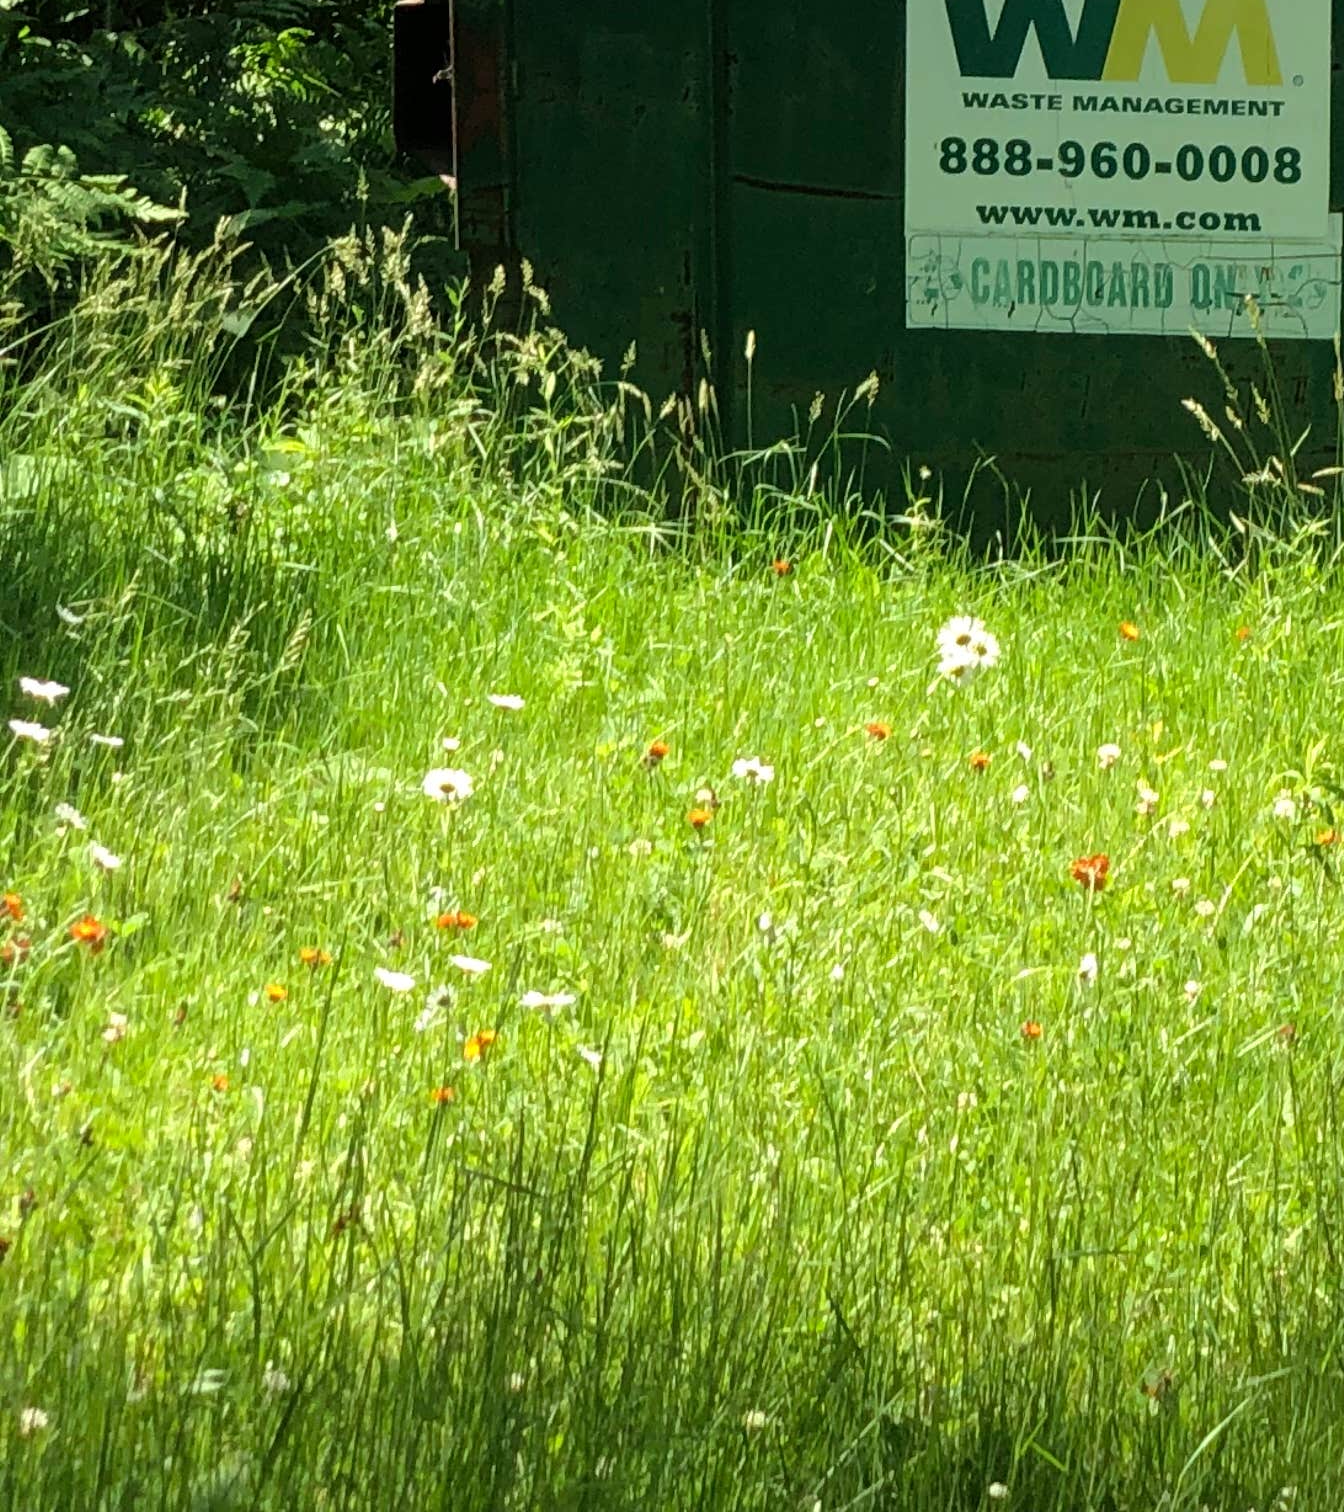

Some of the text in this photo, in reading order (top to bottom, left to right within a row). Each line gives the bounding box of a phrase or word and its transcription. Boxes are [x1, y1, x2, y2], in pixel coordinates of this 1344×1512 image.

[962, 92, 1285, 117] WASTE MANAGEMENT
[939, 136, 1303, 185] 888-960-0008
[975, 204, 1262, 232] www.wm.com
[970, 256, 1174, 309] CARDBOARD
